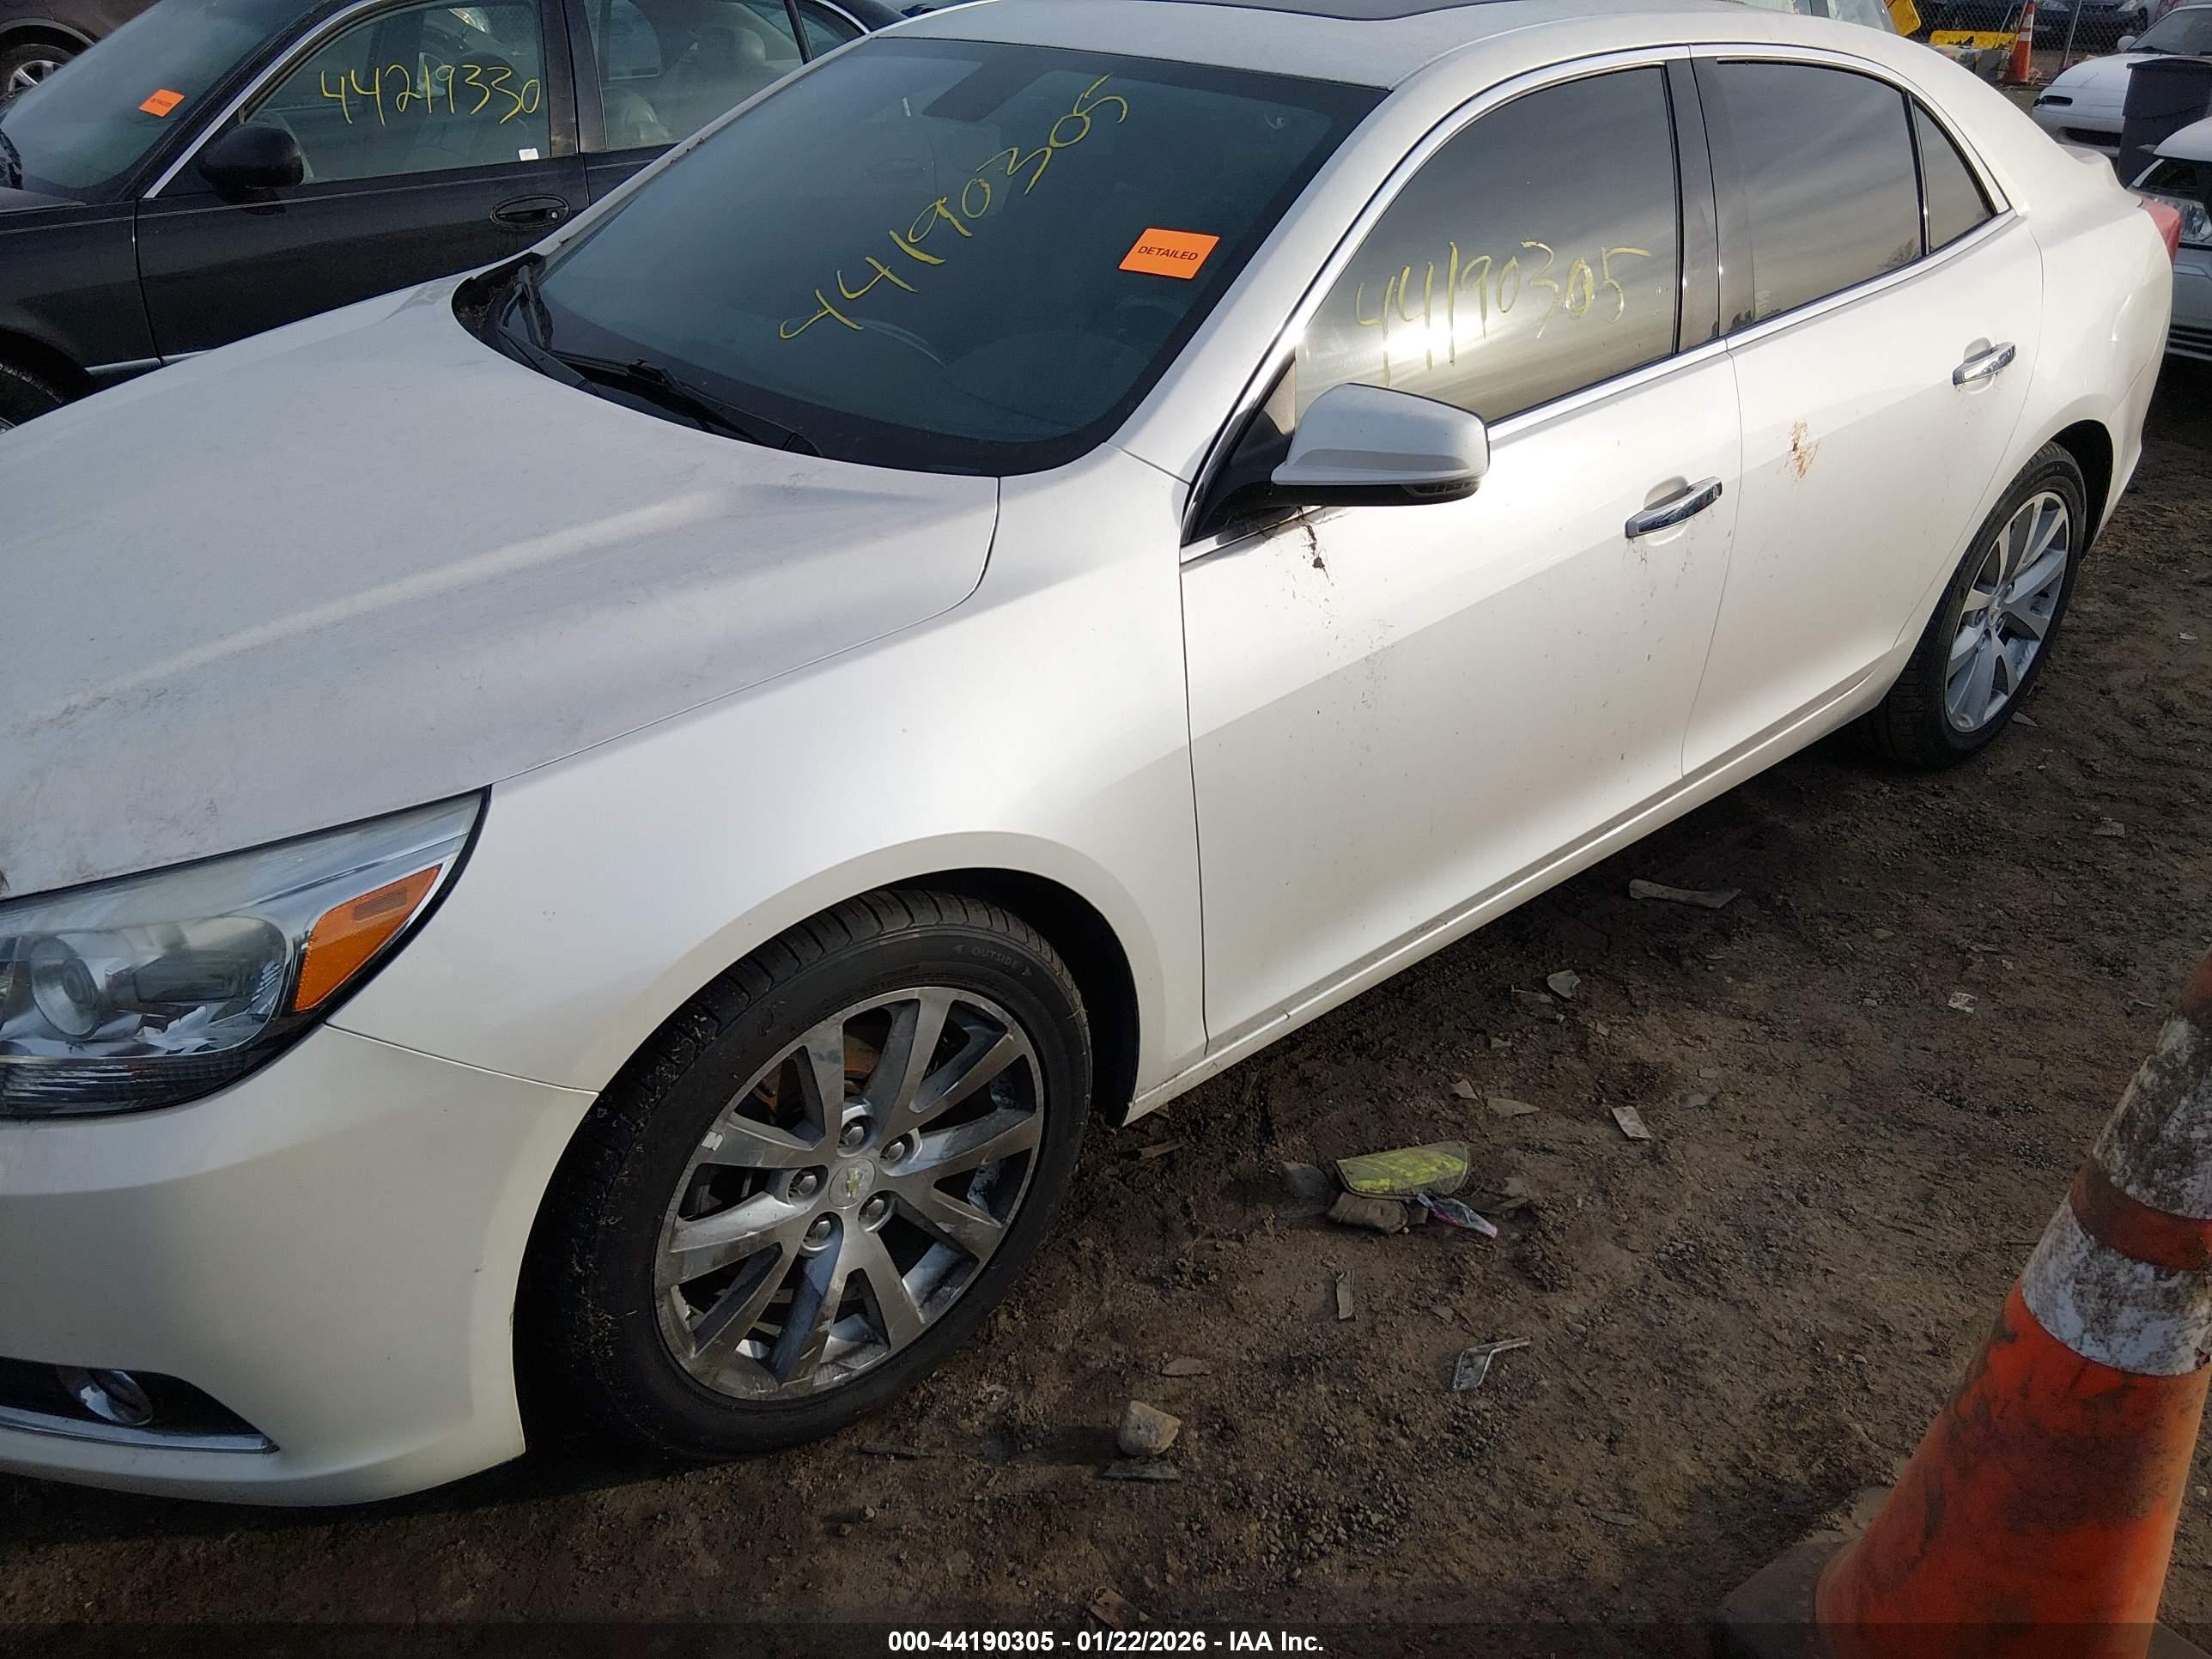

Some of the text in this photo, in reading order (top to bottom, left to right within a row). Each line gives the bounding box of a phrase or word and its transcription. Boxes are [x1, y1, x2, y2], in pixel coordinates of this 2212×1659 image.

[321, 64, 540, 125] 44219330
[780, 72, 1128, 339] 44190305
[1138, 246, 1199, 261] DETAILED
[1356, 241, 1652, 387] 44190305
[973, 947, 1018, 968] OUTSIDE
